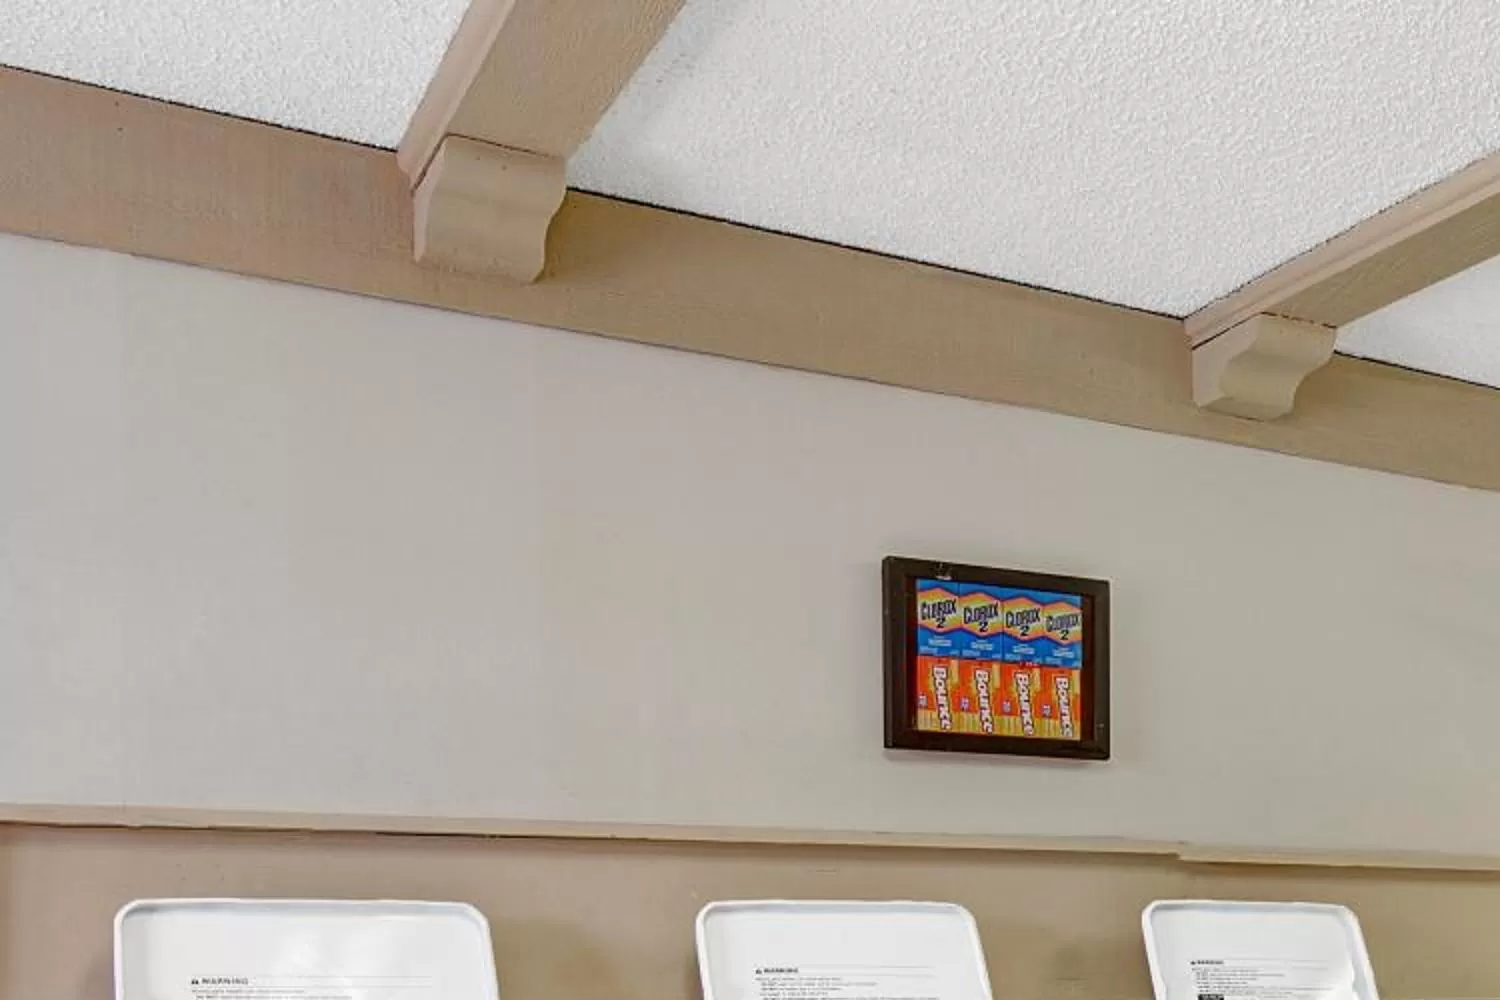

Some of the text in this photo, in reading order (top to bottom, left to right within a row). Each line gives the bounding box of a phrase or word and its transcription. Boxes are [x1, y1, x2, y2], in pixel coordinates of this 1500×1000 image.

[935, 617, 946, 628] 2
[979, 621, 989, 632] 2
[1020, 625, 1030, 636] 2
[1060, 629, 1069, 640] 2
